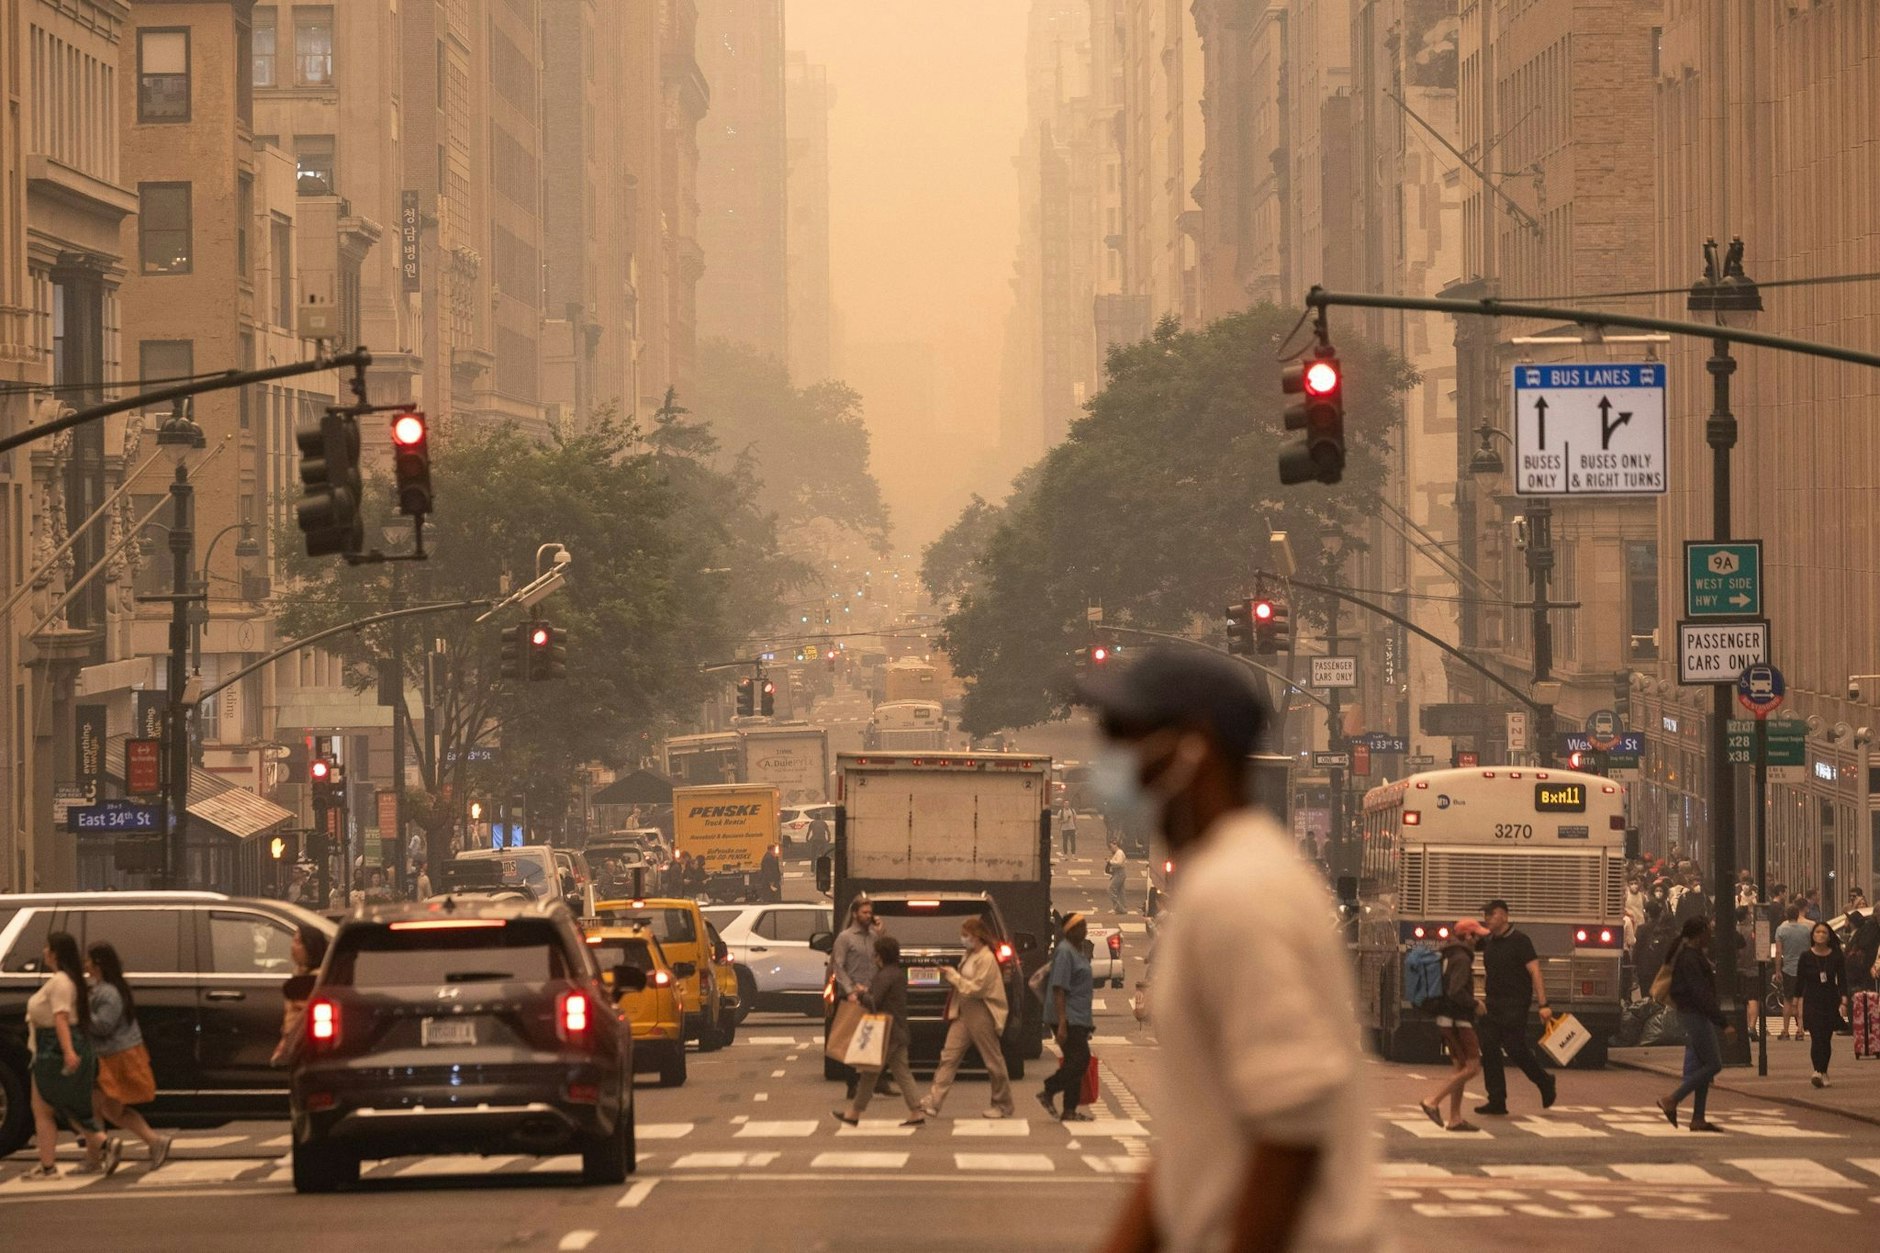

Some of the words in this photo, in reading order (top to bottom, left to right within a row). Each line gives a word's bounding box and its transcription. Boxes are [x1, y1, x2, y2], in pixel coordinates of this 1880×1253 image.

[403, 207, 416, 278] 청담병원
[1551, 370, 1580, 385] BUS
[1585, 370, 1630, 385] LANES
[1524, 455, 1561, 470] BUSES
[1580, 454, 1617, 469] BUSES
[1621, 454, 1652, 469] ONLY
[1528, 474, 1557, 488] ONLY
[1571, 473, 1581, 488] &
[1586, 473, 1620, 487] RIGHT
[1624, 473, 1661, 487] TURNS
[1713, 556, 1733, 570] 9A
[1695, 578, 1723, 590] WEST
[1728, 578, 1752, 589] SIDE
[1695, 595, 1718, 607] HWY
[1687, 632, 1760, 649] PASSENGER
[1315, 661, 1353, 670] PASSENGER
[1687, 655, 1720, 670] CARS
[1315, 672, 1332, 681] CARS
[1336, 672, 1353, 681] ONLY
[1393, 740, 1403, 750] St
[1567, 738, 1593, 750] Wes
[1625, 738, 1638, 750] St
[1728, 735, 1750, 747] x28
[1728, 751, 1750, 762] x38
[858, 778, 867, 786] 2
[1024, 780, 1032, 789] 2
[1541, 787, 1580, 805] BxM11
[689, 804, 761, 818] PENSKE
[78, 813, 106, 827] East
[109, 811, 134, 826] 34th
[137, 811, 151, 826] St
[704, 819, 722, 827] Truck
[1494, 824, 1533, 839] 3270
